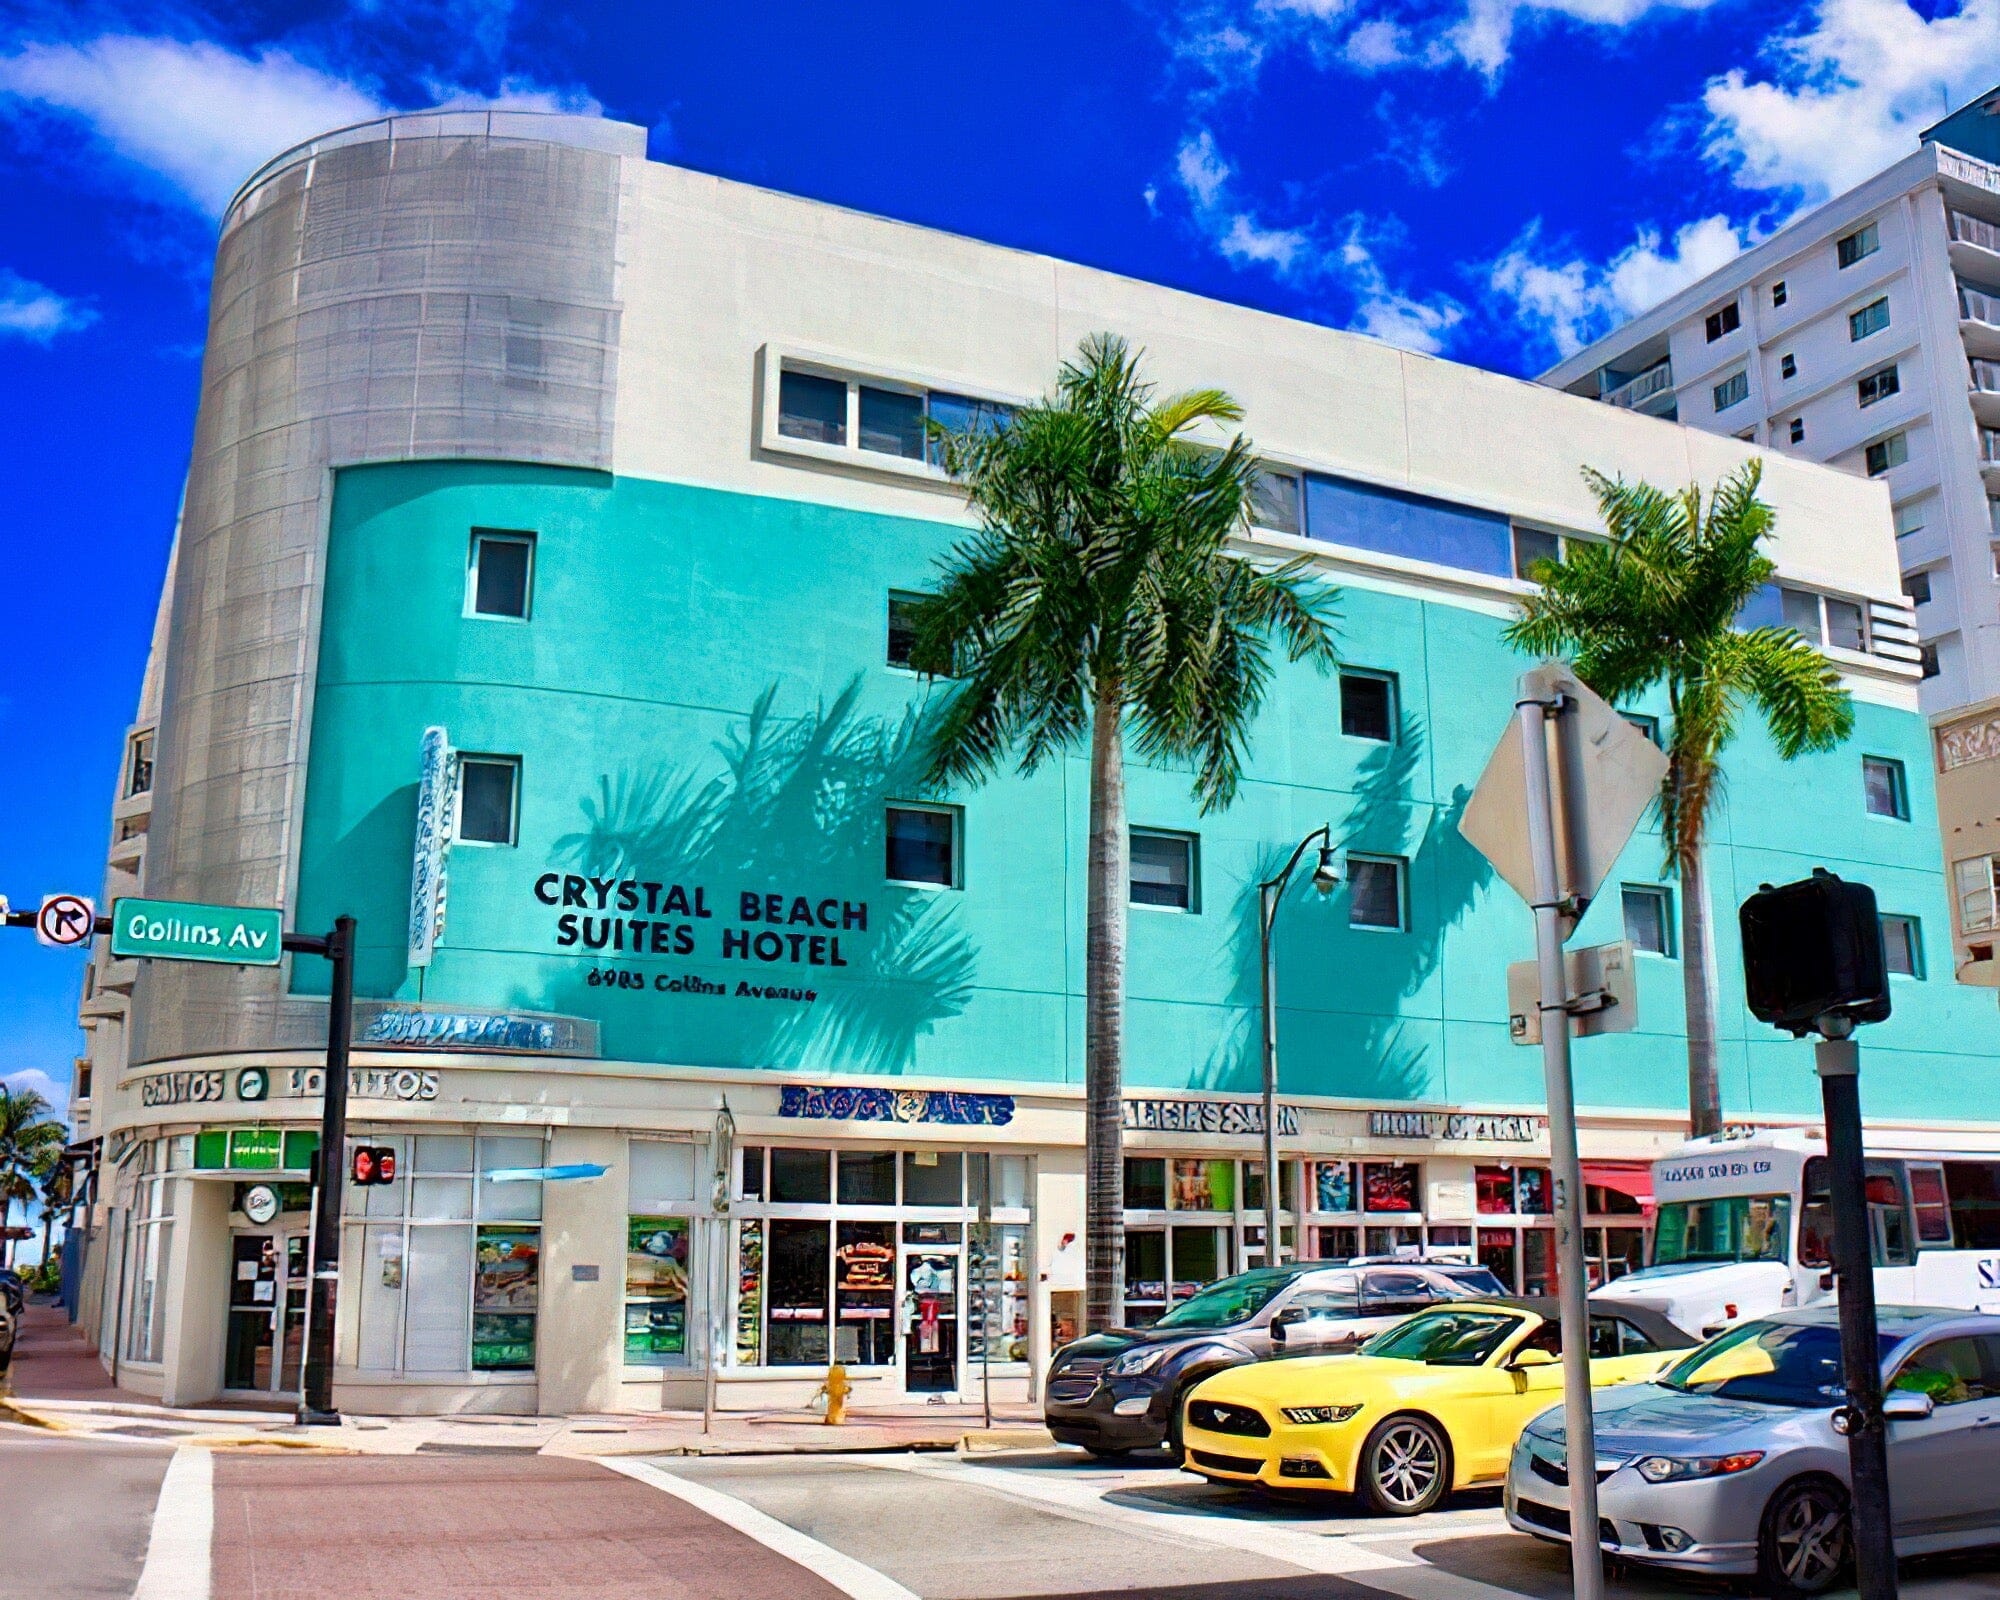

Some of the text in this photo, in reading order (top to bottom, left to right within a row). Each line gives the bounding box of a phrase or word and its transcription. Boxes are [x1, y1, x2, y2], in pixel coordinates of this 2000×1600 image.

[533, 872, 869, 932] CRYSTAL BEACH
[128, 914, 268, 949] Collins Av
[556, 914, 849, 967] SUITES HOTEL
[654, 973, 727, 997] Collins
[733, 980, 819, 1003] Avenue
